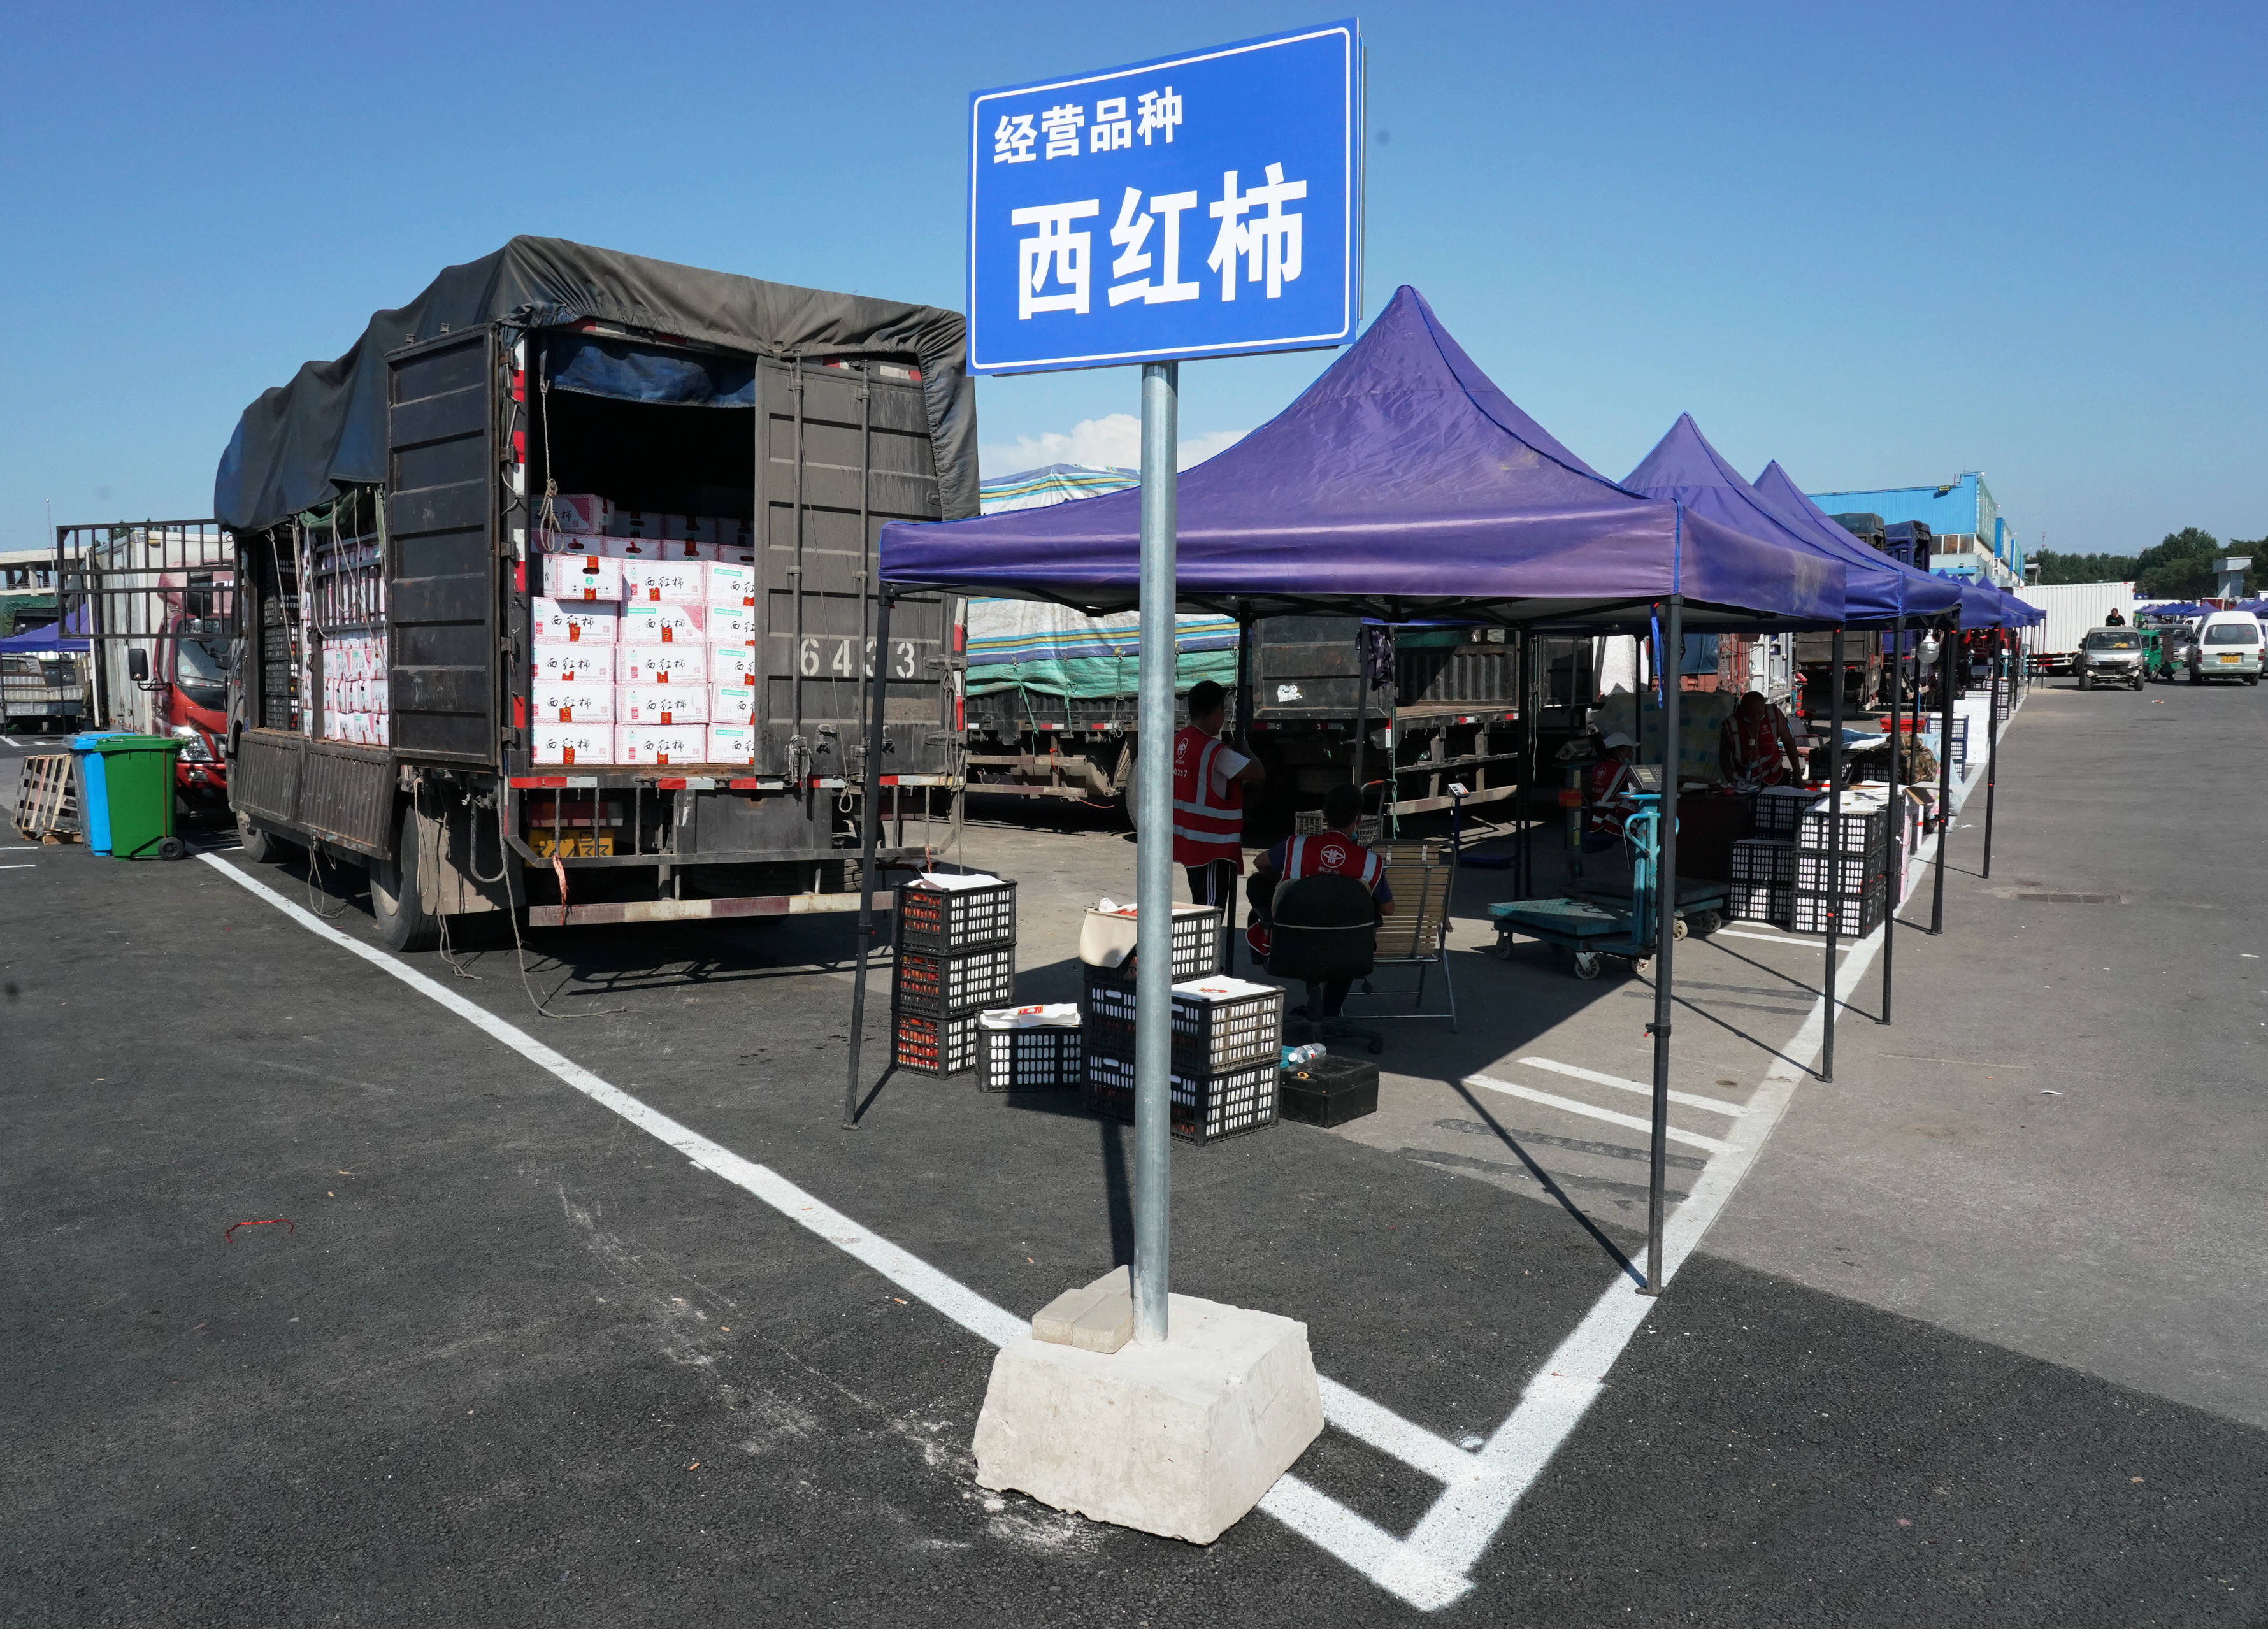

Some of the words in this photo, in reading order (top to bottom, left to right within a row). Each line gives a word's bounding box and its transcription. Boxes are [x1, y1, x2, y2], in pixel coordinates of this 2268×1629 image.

[993, 85, 1183, 164] 经营品种
[1011, 162, 1307, 320] 西红柿
[535, 510, 572, 522] 西柿
[645, 576, 684, 589] 西红柿
[551, 615, 594, 629] 西红柿
[646, 617, 685, 631] 西红柿
[547, 657, 591, 671] 西红柿
[645, 658, 685, 671] 西红柿
[547, 696, 591, 710] 西红柿
[646, 699, 687, 712] 西红柿
[546, 738, 591, 752] 西红柿
[643, 739, 685, 752] 西红柿
